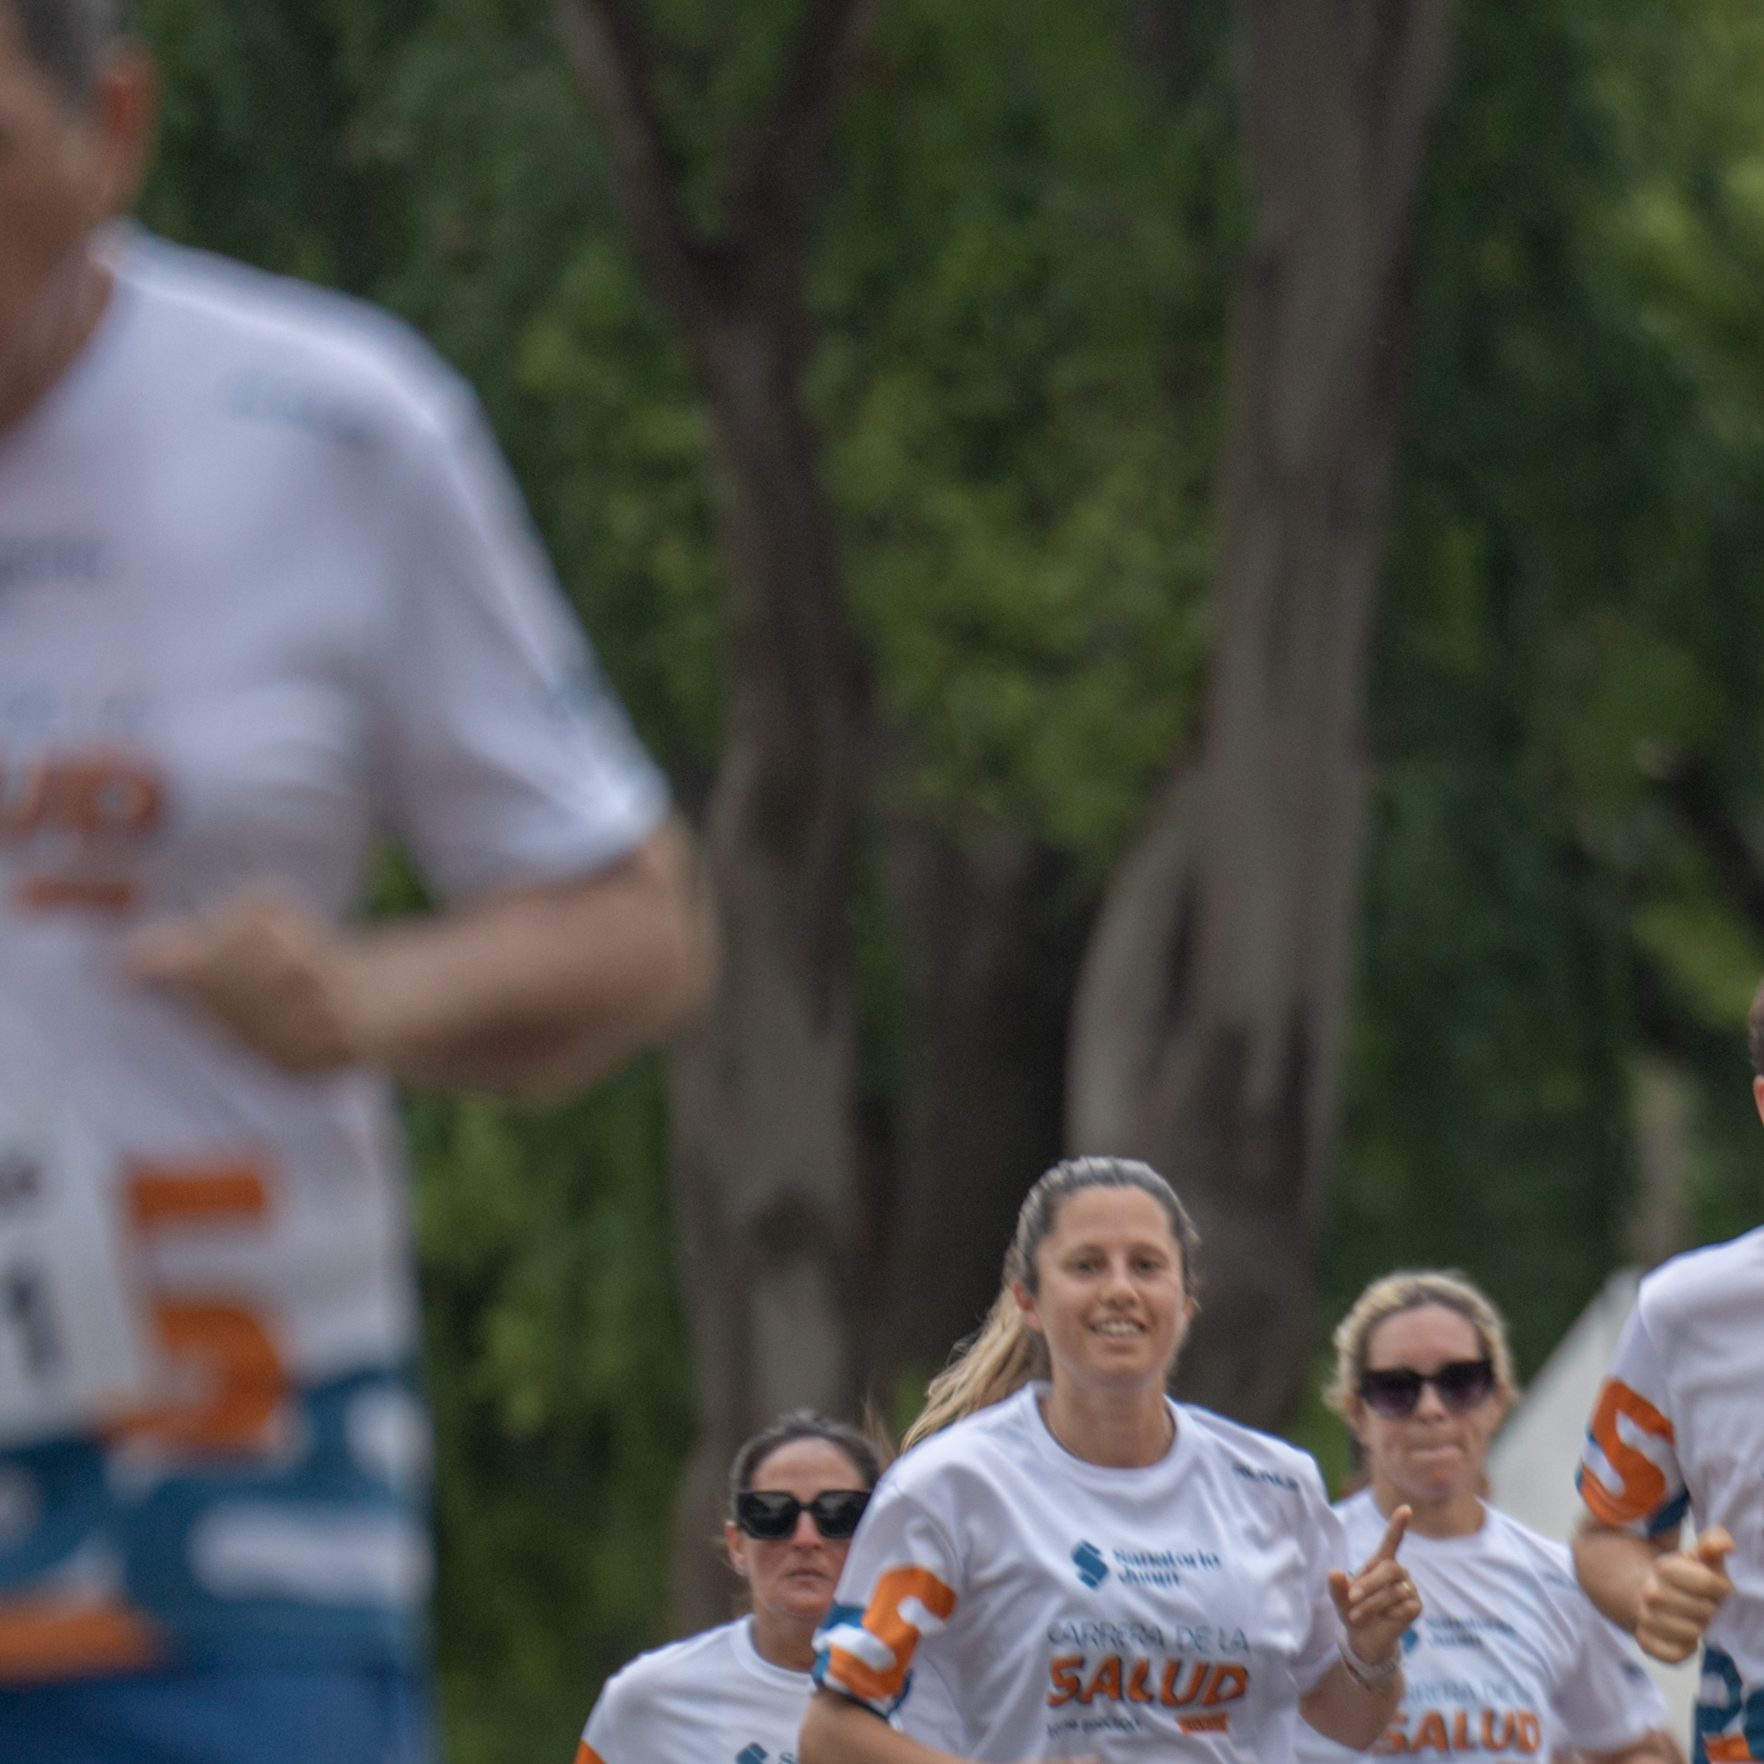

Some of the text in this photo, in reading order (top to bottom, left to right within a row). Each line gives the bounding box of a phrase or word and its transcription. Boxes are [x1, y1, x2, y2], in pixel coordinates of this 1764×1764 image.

[1047, 1620, 1250, 1654] CARRERA DE LA
[1047, 1654, 1249, 1708] SALUD
